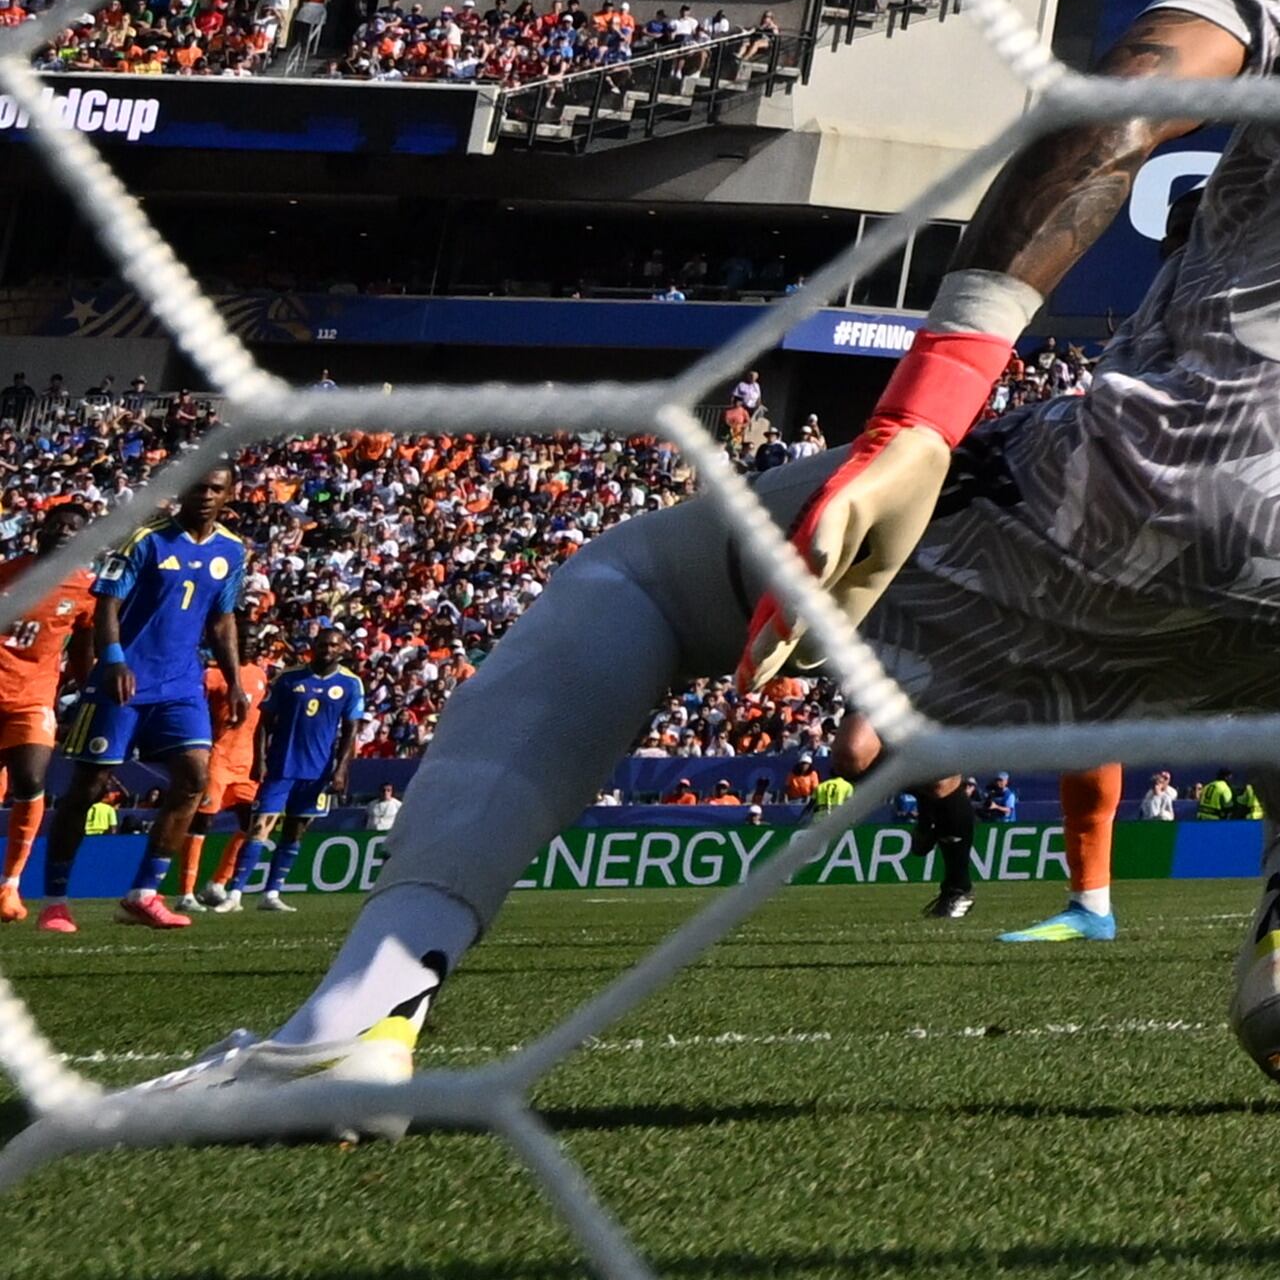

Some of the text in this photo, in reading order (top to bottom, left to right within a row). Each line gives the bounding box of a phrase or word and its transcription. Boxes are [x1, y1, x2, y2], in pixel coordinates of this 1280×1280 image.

[316, 328, 338, 340] 112
[181, 580, 196, 611] 1
[306, 698, 320, 717] 9
[316, 792, 327, 812] 9
